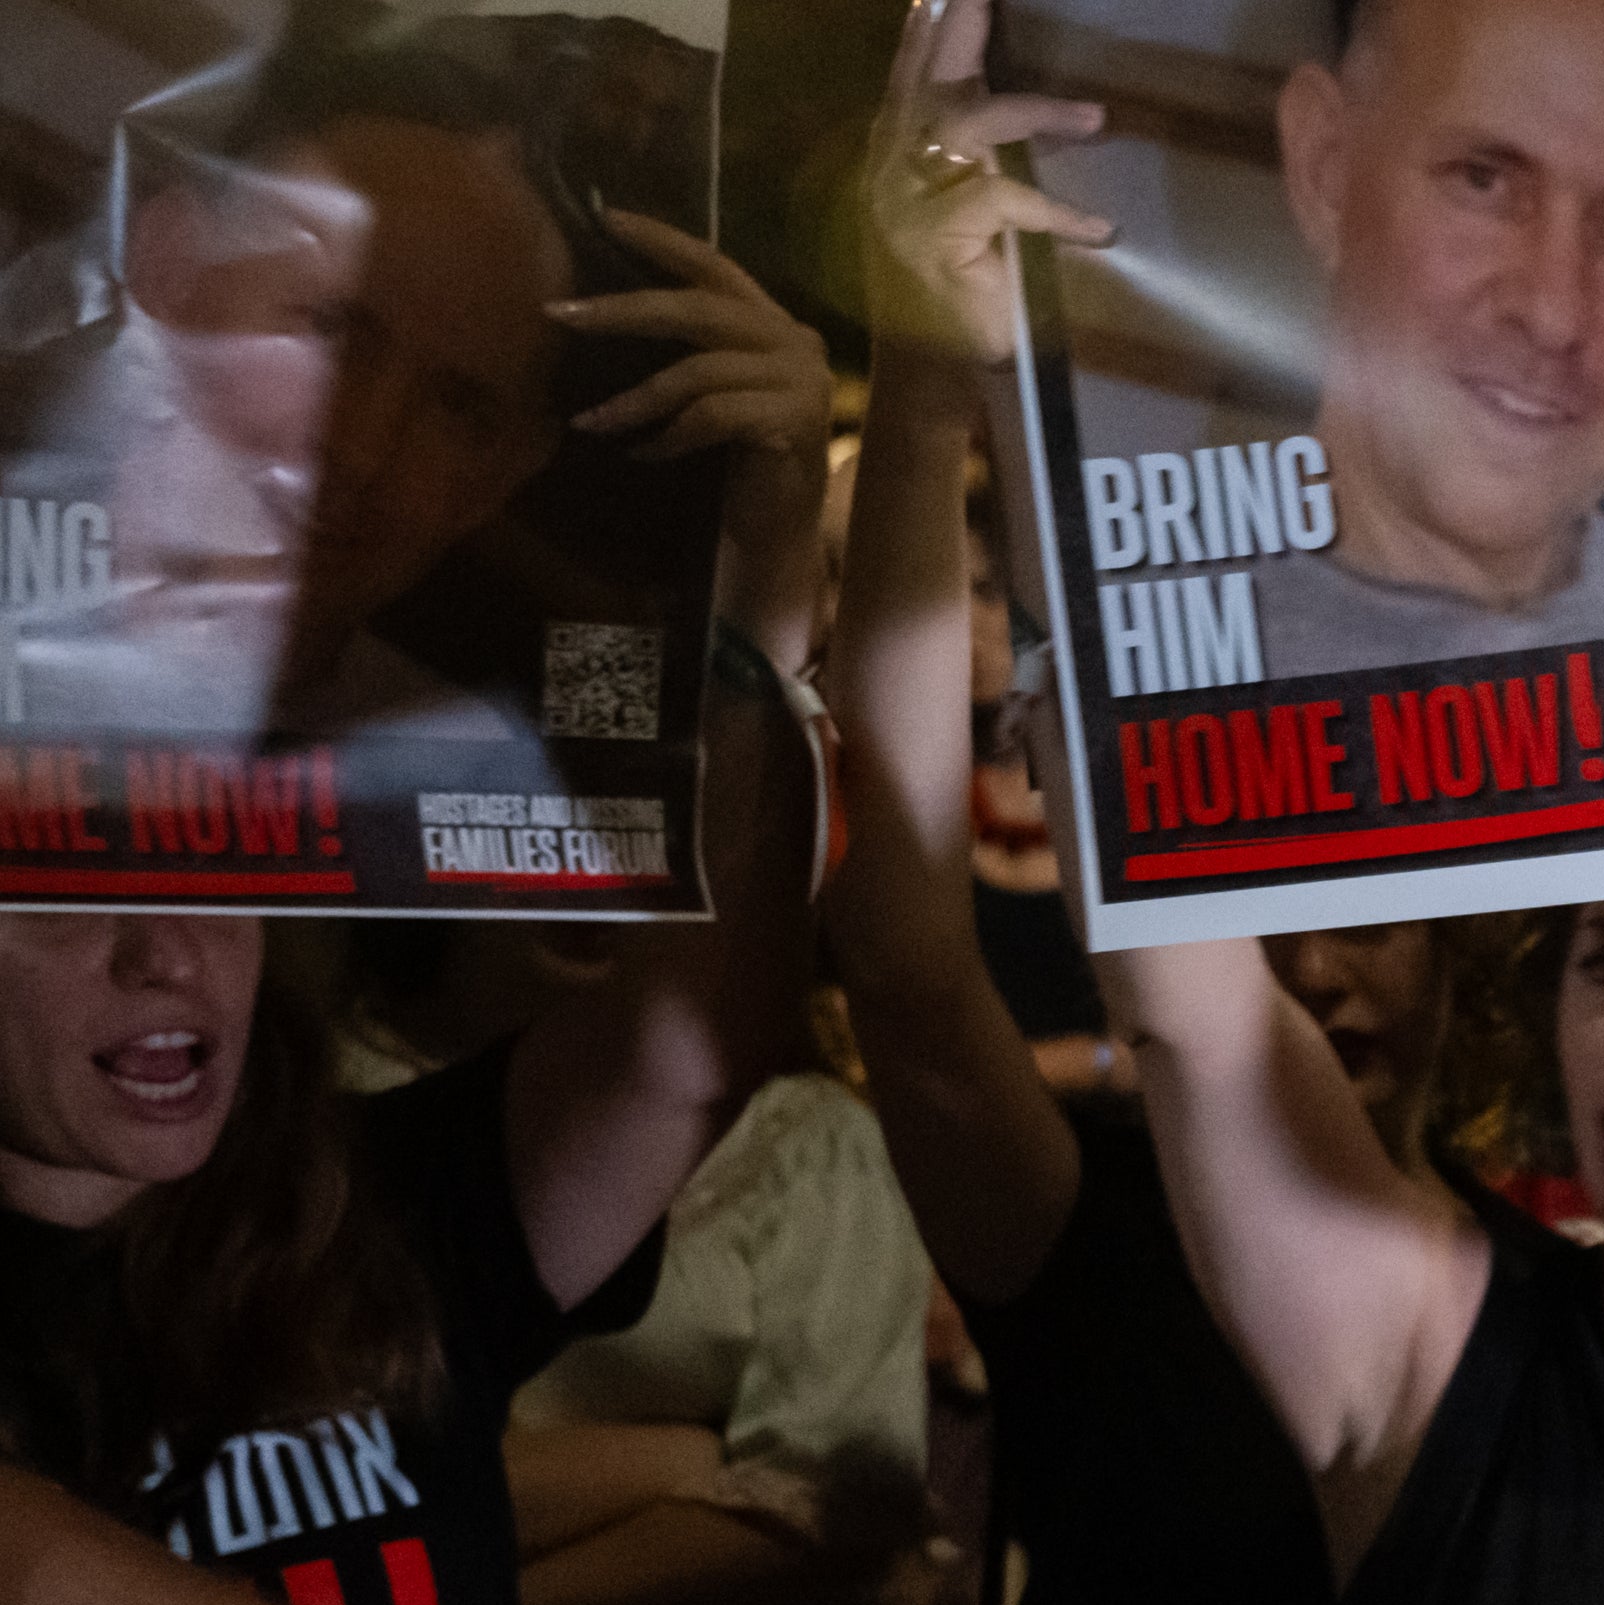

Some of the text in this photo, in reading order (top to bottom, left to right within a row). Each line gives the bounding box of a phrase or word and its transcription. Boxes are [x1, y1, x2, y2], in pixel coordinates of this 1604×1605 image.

[1080, 435, 1338, 572] BRING
[1098, 570, 1265, 698] HIM
[126, 743, 343, 858] NOW!
[1118, 700, 1356, 834] HOME
[422, 826, 669, 876] FAMILIES FORUM
